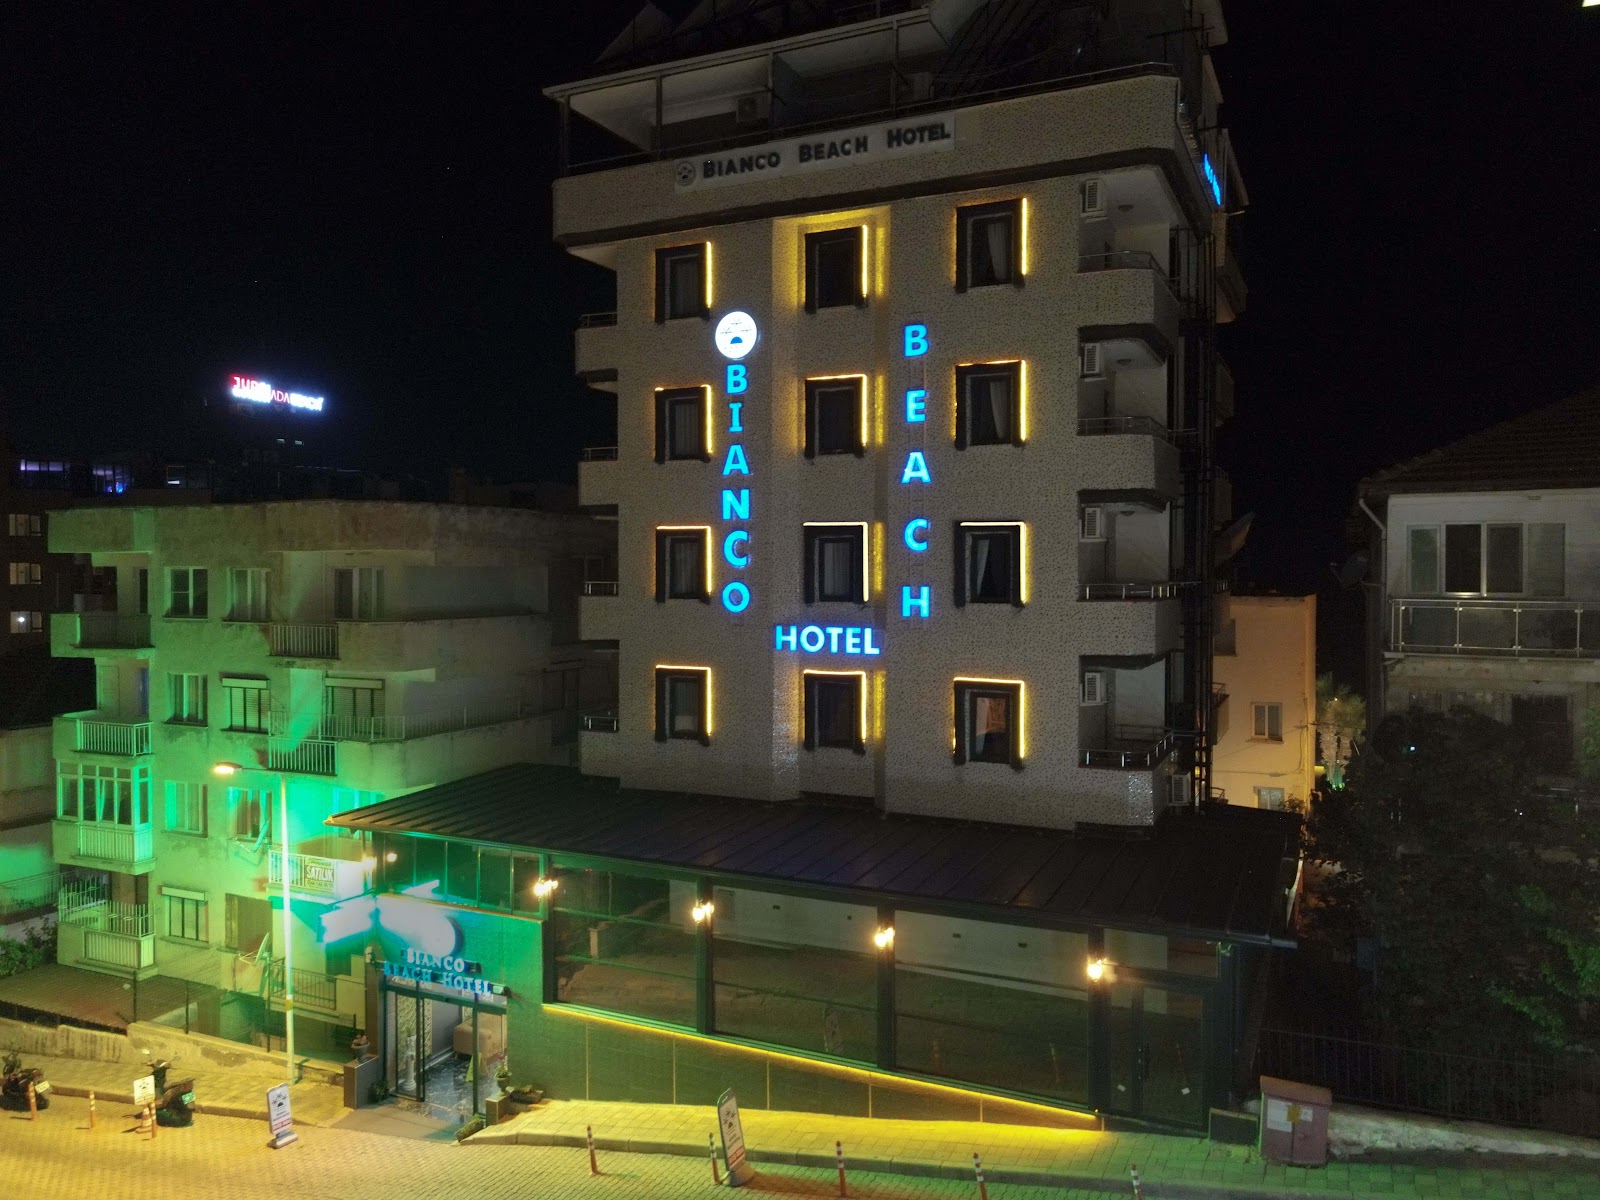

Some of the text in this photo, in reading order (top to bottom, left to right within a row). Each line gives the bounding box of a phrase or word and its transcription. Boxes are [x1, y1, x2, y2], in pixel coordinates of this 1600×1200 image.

[702, 122, 951, 180] BIANCO BEACH HOTEL
[721, 364, 750, 613] BIANCO
[901, 324, 931, 618] BEACH
[775, 625, 880, 655] HOTEL
[384, 961, 491, 995] BEACH HOTEL
[407, 948, 465, 972] BIANCO
